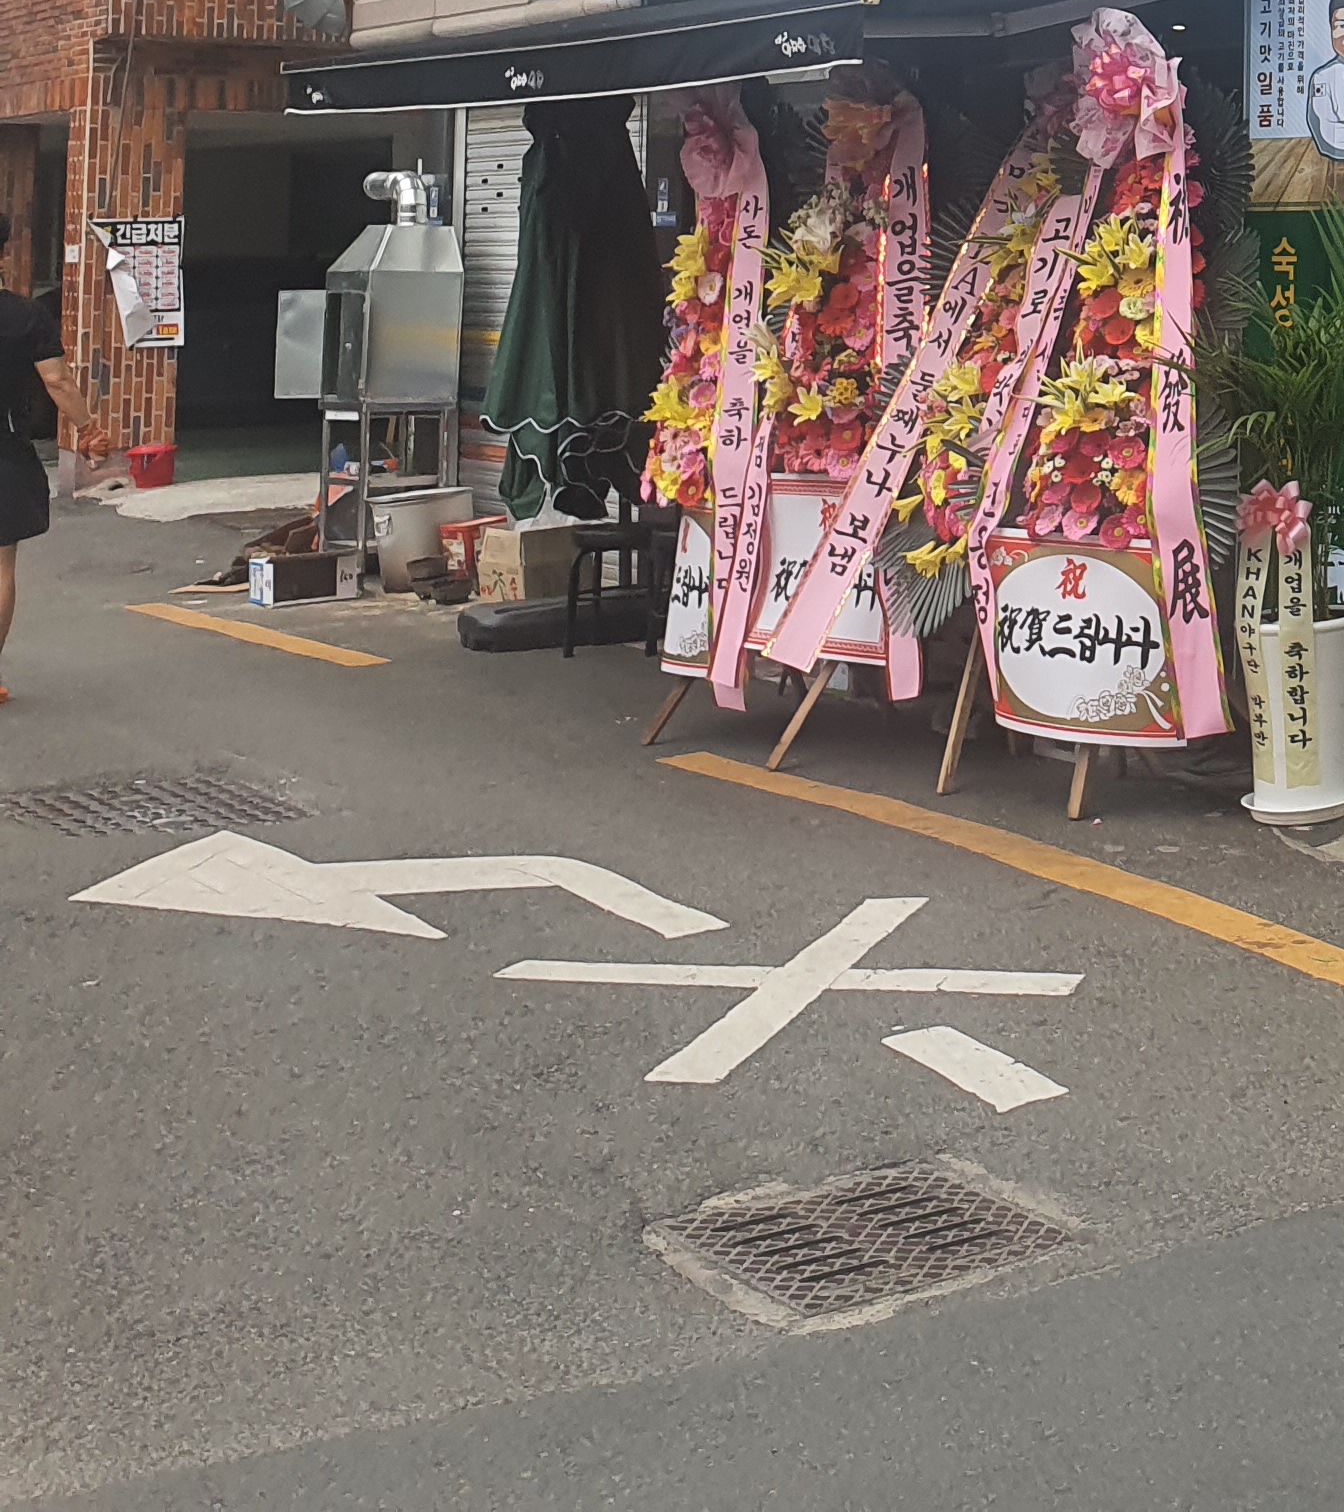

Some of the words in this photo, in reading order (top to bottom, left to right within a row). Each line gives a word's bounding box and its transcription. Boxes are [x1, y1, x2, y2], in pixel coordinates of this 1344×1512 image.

[1257, 71, 1274, 128] 일품
[1021, 217, 1071, 319] 고기로
[719, 397, 750, 451] 축하
[827, 512, 871, 576] 보냄
[1055, 557, 1088, 600] 祝
[1284, 641, 1313, 750] 축하합니다
